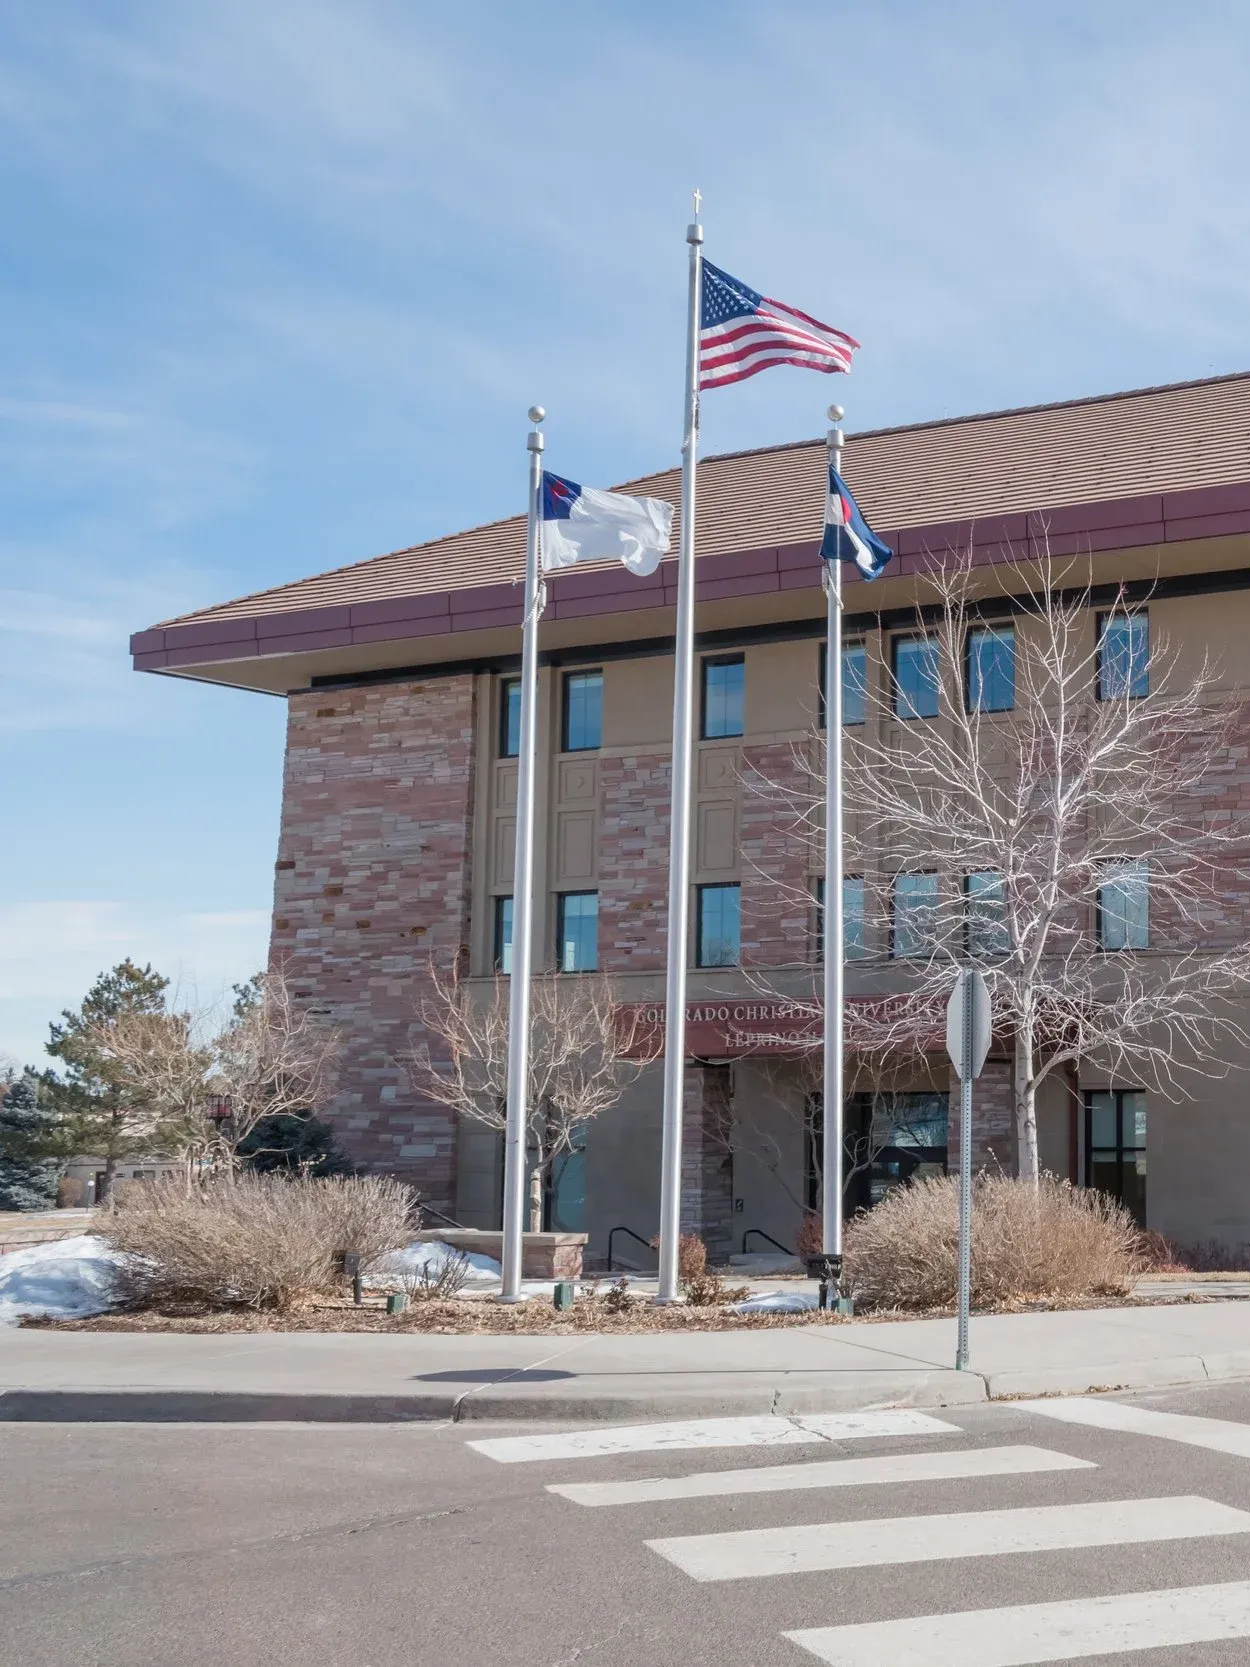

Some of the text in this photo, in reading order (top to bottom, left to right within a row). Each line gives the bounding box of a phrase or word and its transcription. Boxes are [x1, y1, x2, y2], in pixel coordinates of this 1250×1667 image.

[636, 1000, 947, 1023] COLRADO CHRISTIA NIVERSITY
[725, 1032, 800, 1047] LEPRINO
